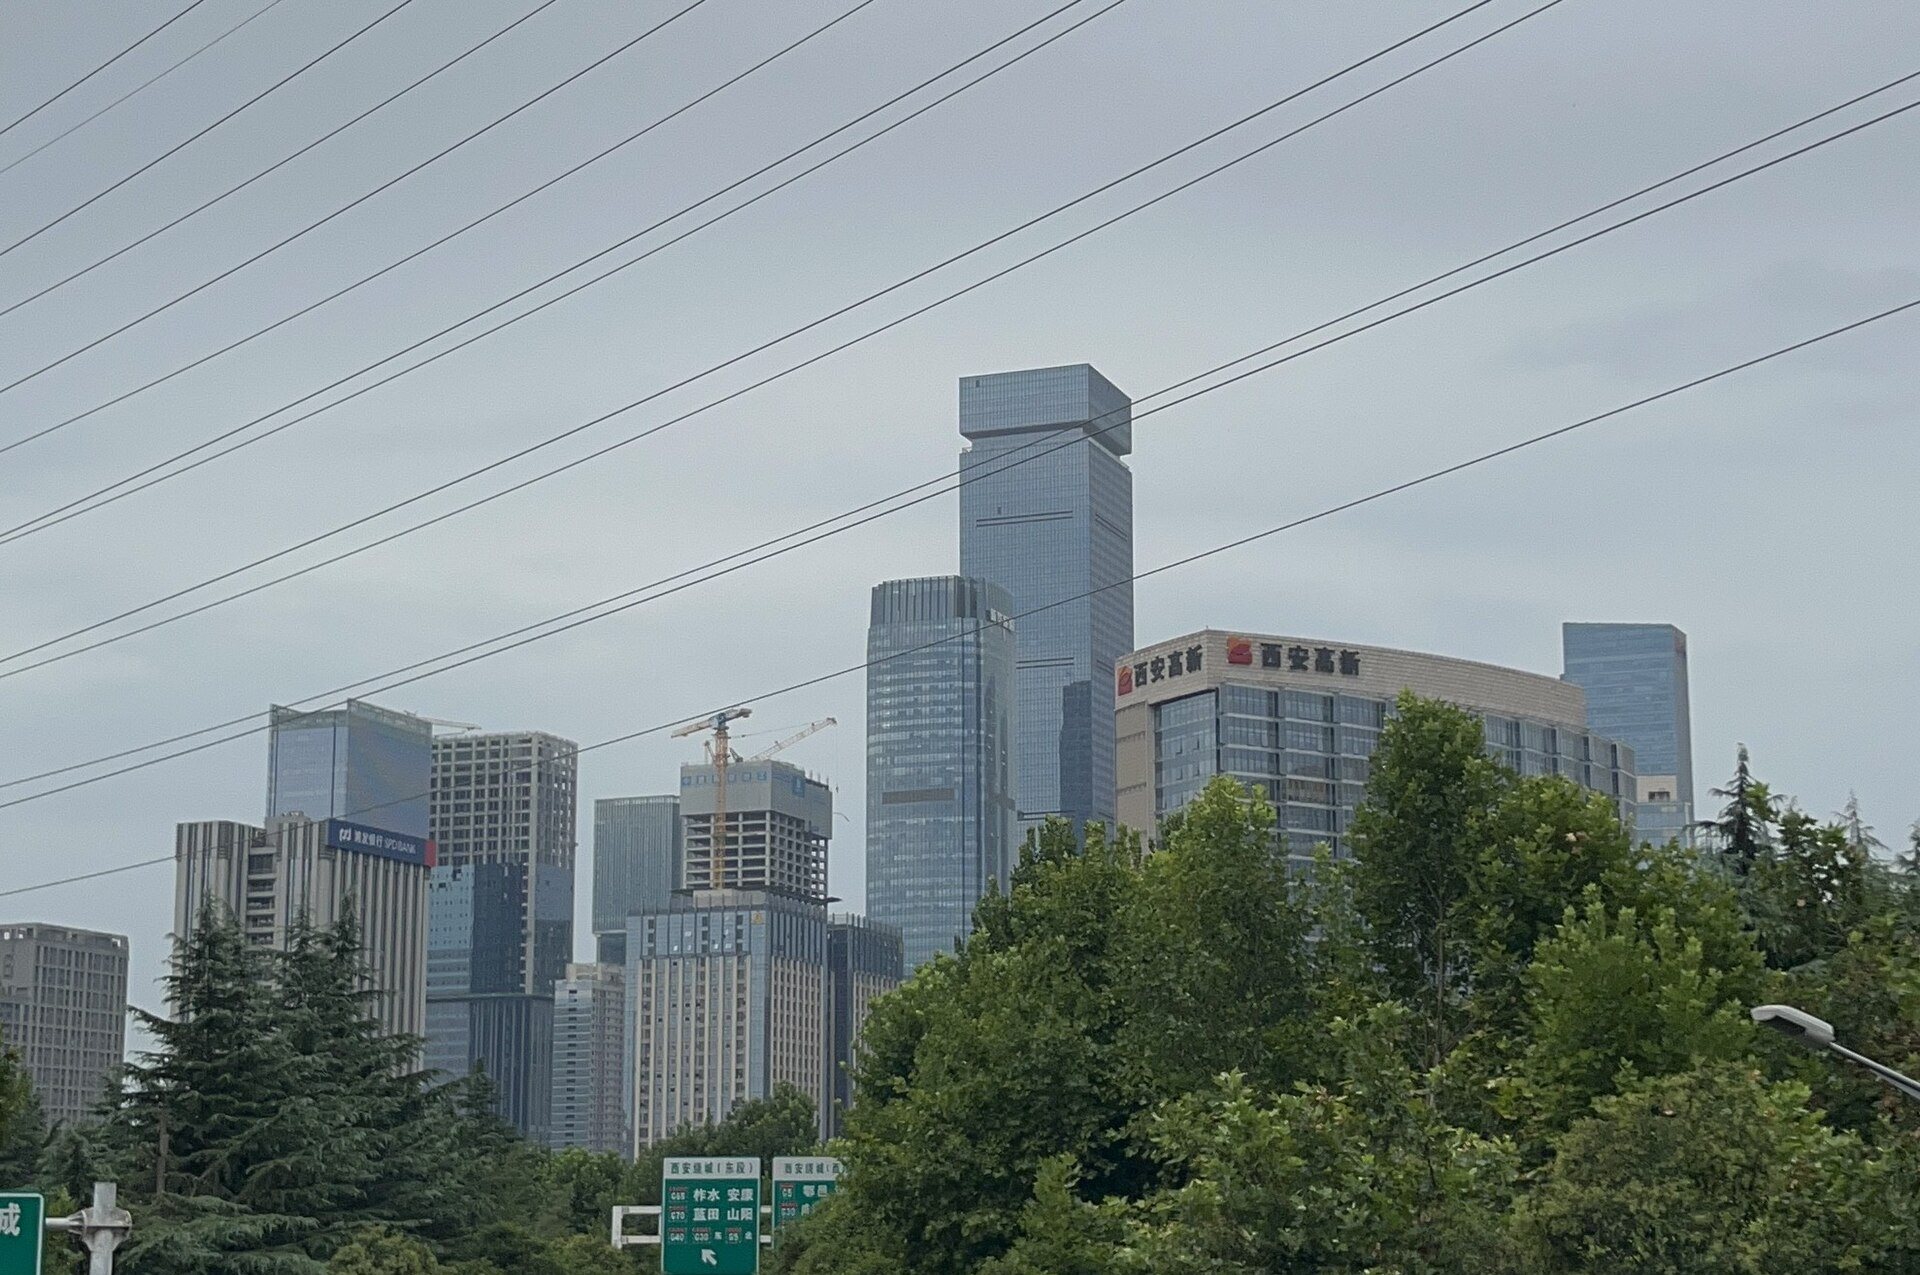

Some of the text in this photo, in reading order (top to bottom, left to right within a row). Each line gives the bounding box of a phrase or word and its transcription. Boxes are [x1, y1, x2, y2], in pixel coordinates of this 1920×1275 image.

[1133, 644, 1203, 687] 西安高新
[1260, 643, 1361, 676] 西安高新
[693, 1188, 720, 1202] 柞水
[727, 1187, 754, 1201] 安康
[693, 1207, 719, 1221] 蓝田
[727, 1207, 753, 1221] 山阳
